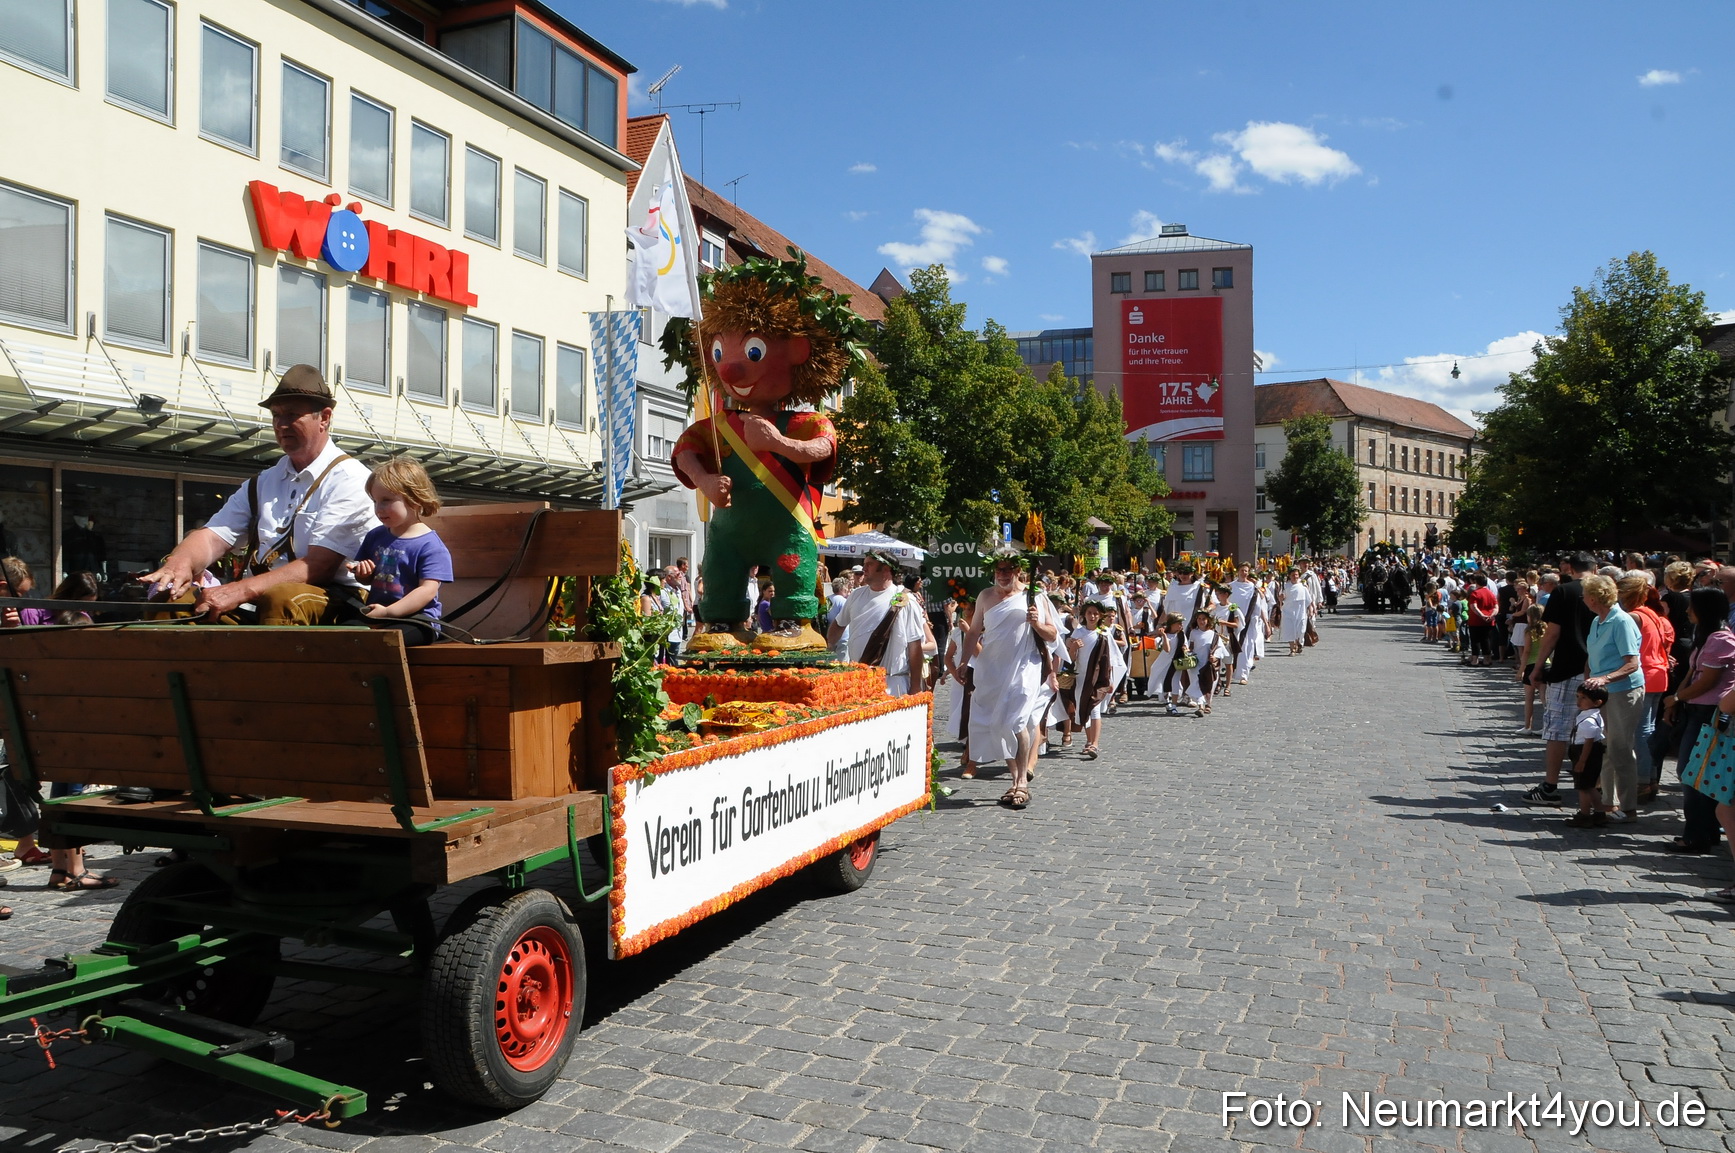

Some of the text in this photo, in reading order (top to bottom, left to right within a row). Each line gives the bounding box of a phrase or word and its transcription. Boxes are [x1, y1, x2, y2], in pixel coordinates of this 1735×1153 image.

[249, 180, 478, 308] WÖHRL
[1128, 332, 1165, 344] Danke
[1128, 347, 1189, 356] für Ihr Vertrauen
[1128, 356, 1184, 366] und Ihre Treue.
[1159, 382, 1193, 397] 175
[1160, 396, 1193, 406] JAHRE
[941, 542, 976, 554] OGV
[645, 733, 912, 880] Verein für Gartenbau u. Heimatpflege Stauf
